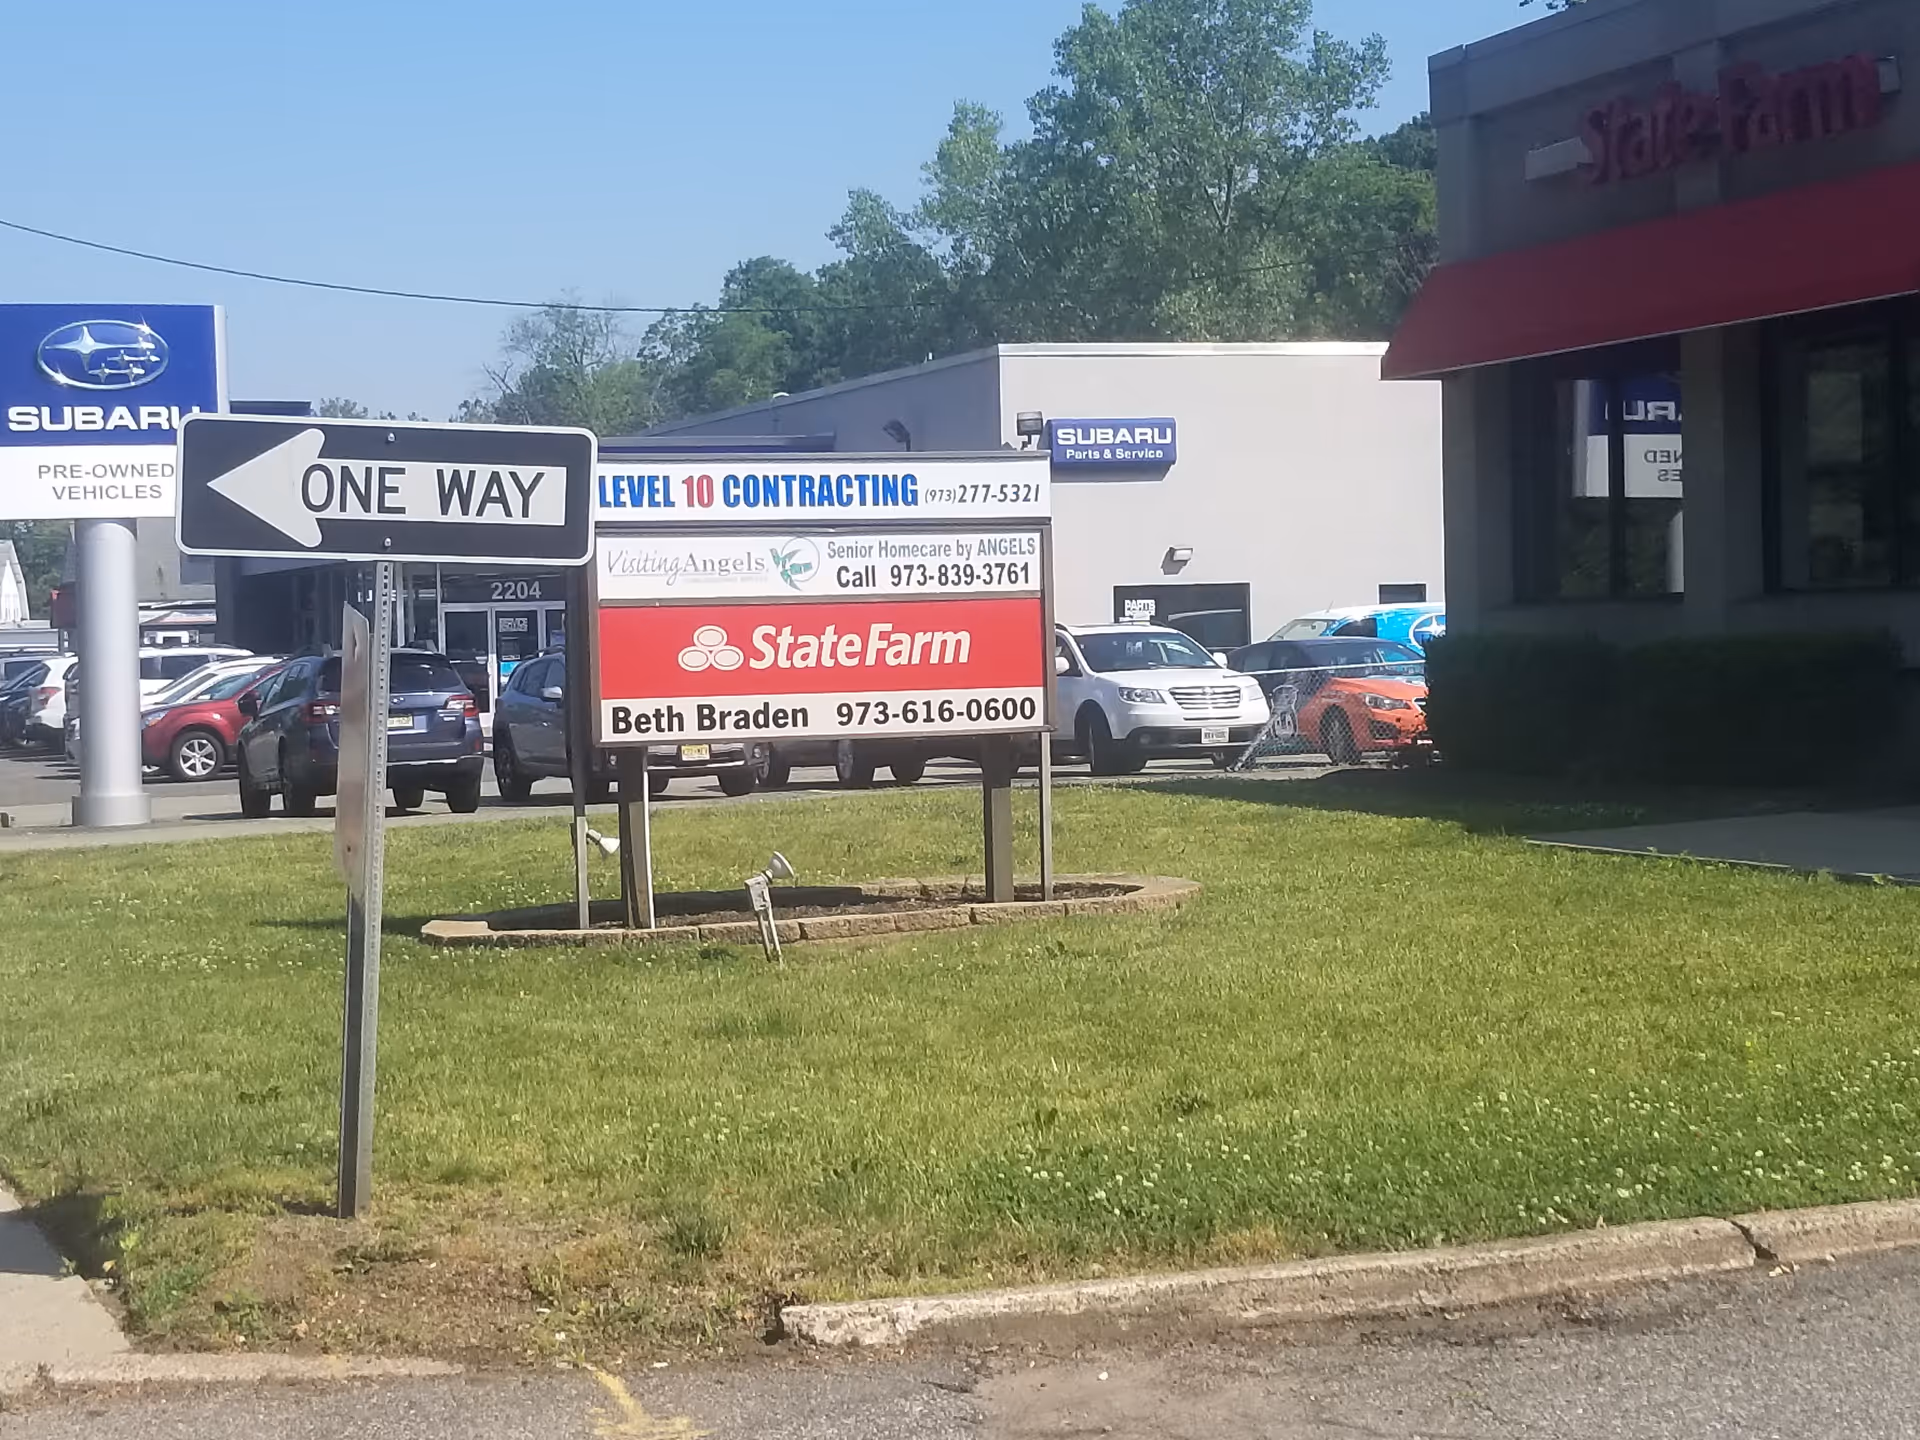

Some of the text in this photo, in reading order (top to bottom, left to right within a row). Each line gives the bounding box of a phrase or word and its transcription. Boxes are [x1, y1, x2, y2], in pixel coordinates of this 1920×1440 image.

[1056, 427, 1172, 445] SUBARU
[1066, 448, 1164, 459] Parts & Service
[38, 463, 174, 479] PRE-OWNED
[52, 484, 162, 500] VEHICLES
[301, 463, 546, 518] ONE WAY
[599, 475, 676, 508] LEVEL
[681, 474, 715, 508] 10
[722, 473, 919, 508] CONTRACTING
[827, 537, 1036, 565] Senior Homecare by ANGELS
[836, 562, 1030, 588] Call 973-839-3761
[491, 581, 542, 600] 2204
[612, 697, 1036, 734] Beth Braden 973-616-0600
